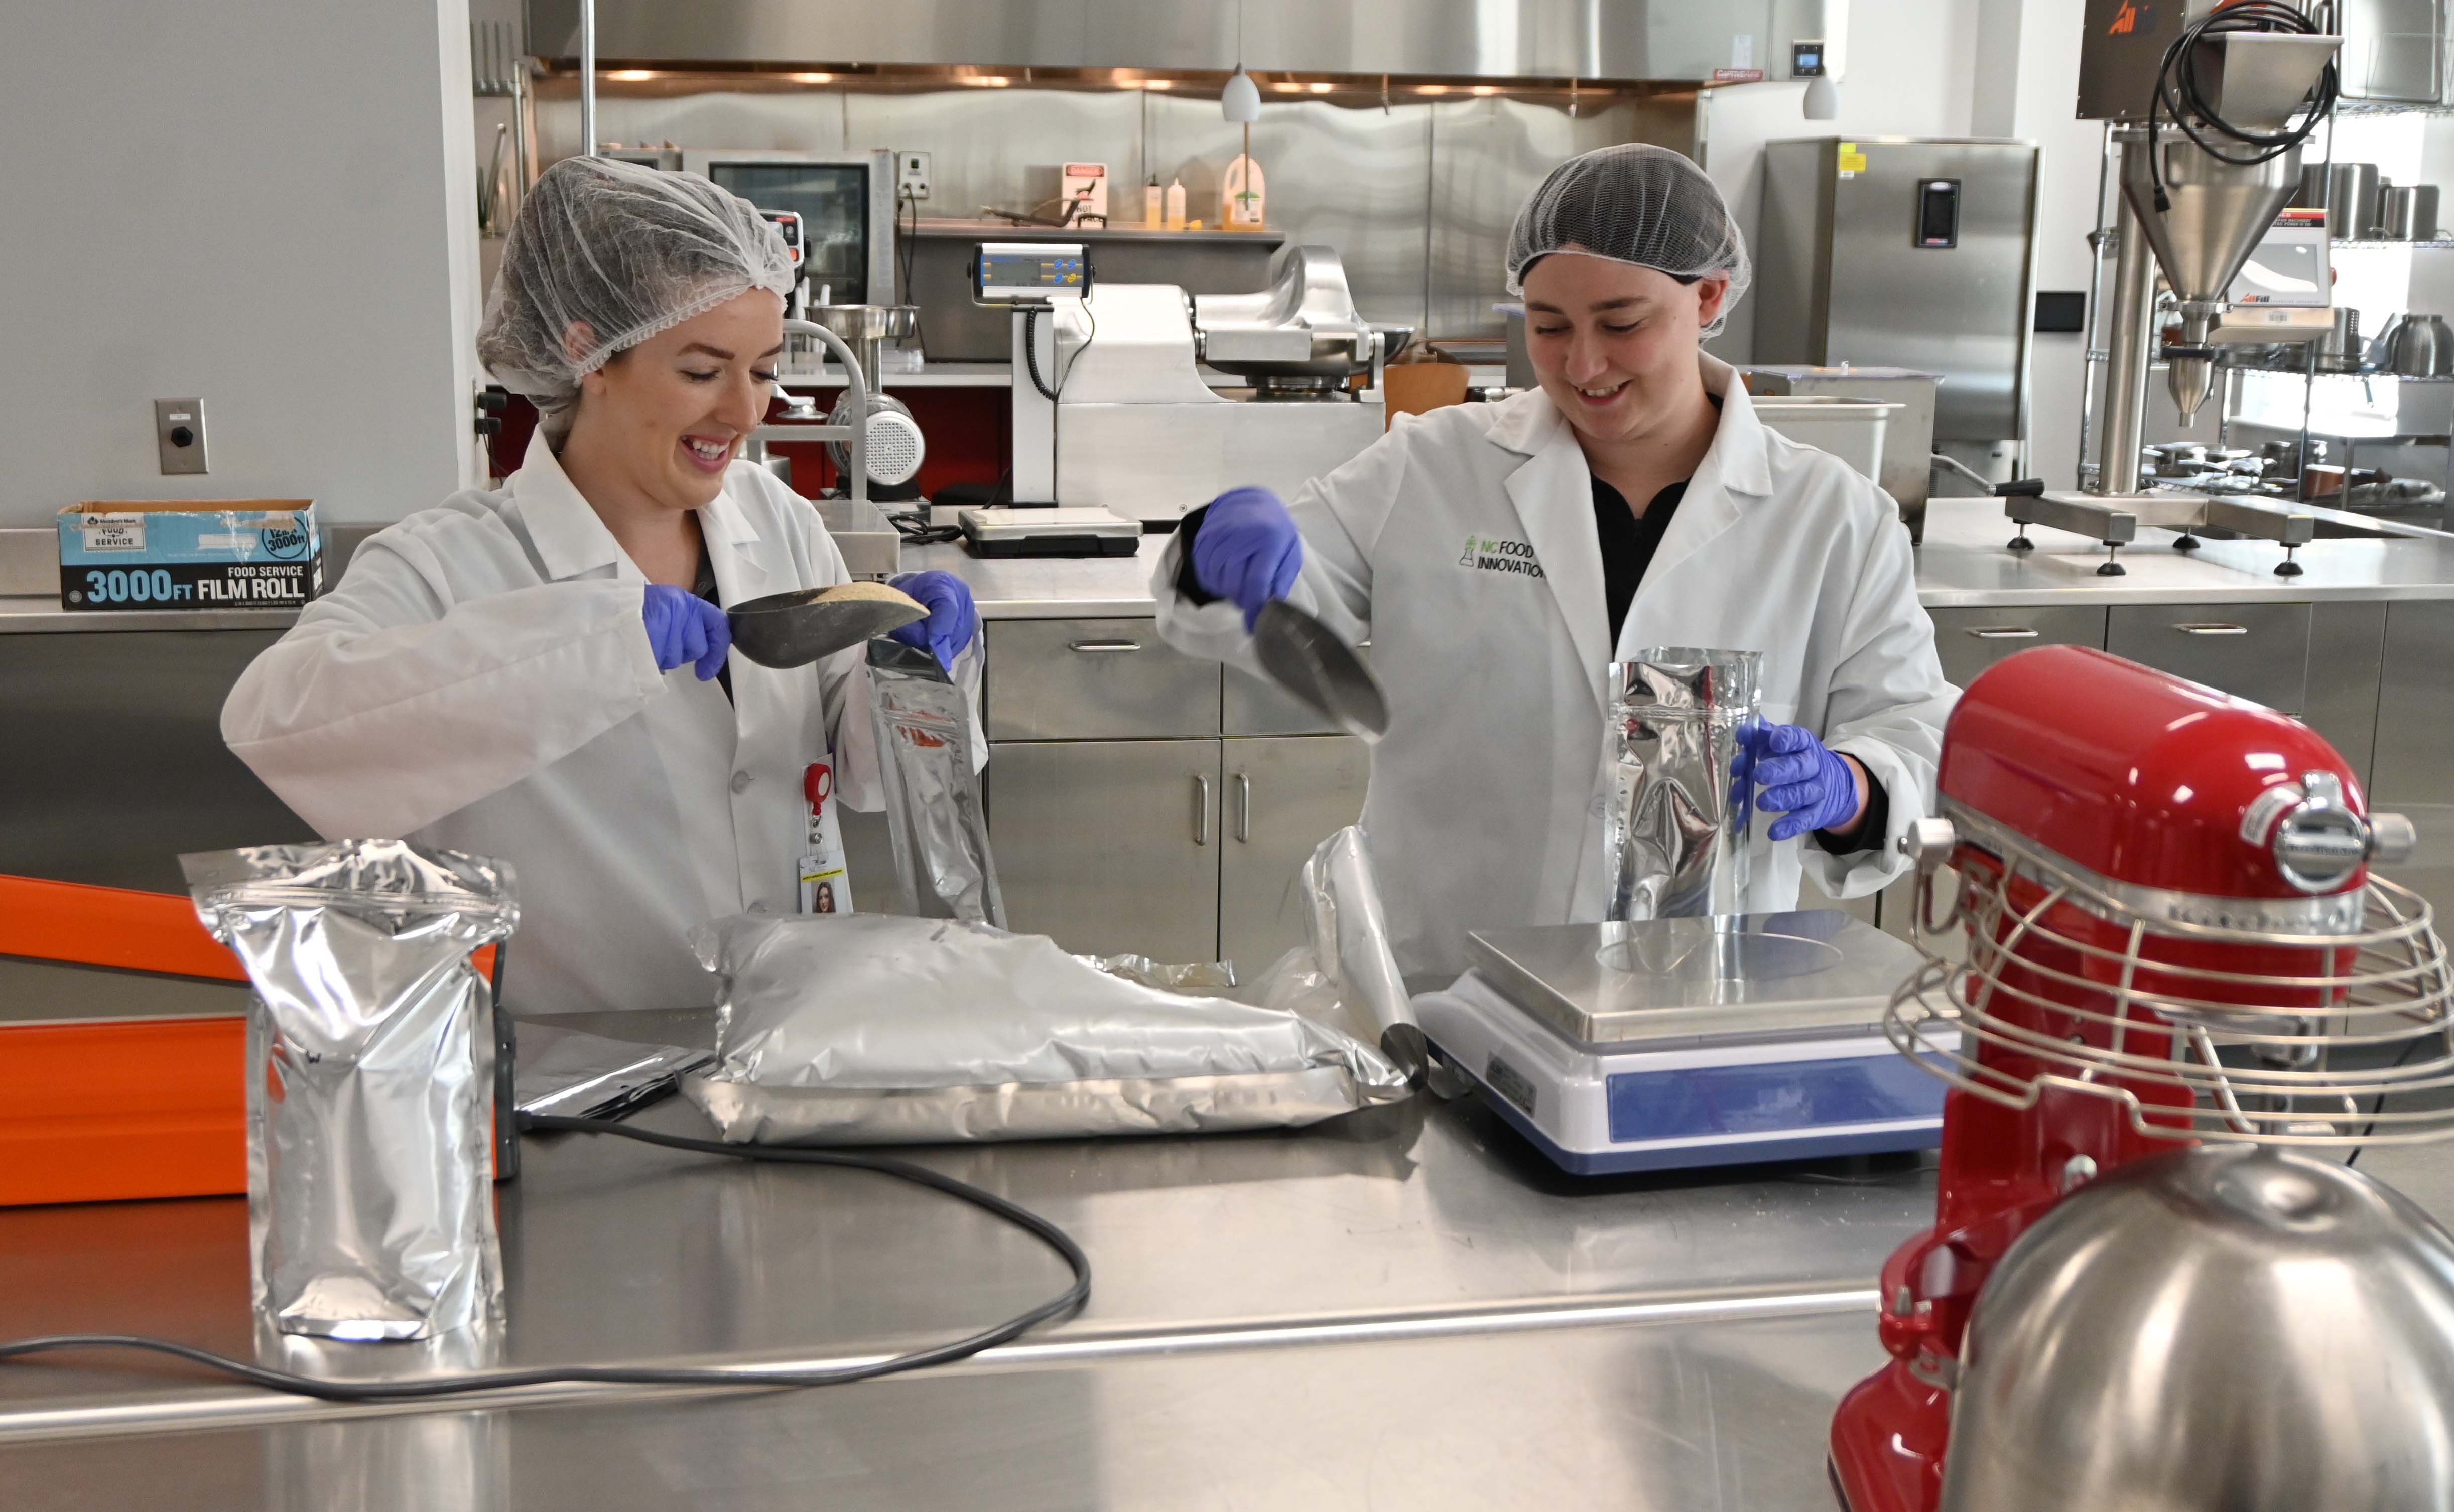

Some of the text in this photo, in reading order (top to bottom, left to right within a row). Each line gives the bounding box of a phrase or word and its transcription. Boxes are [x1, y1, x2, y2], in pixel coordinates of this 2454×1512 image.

[268, 534, 305, 551] 3000ft
[1499, 541, 1534, 558] FOOD
[228, 566, 303, 577] FOOD SERVICE
[198, 578, 305, 600] FILM ROLL
